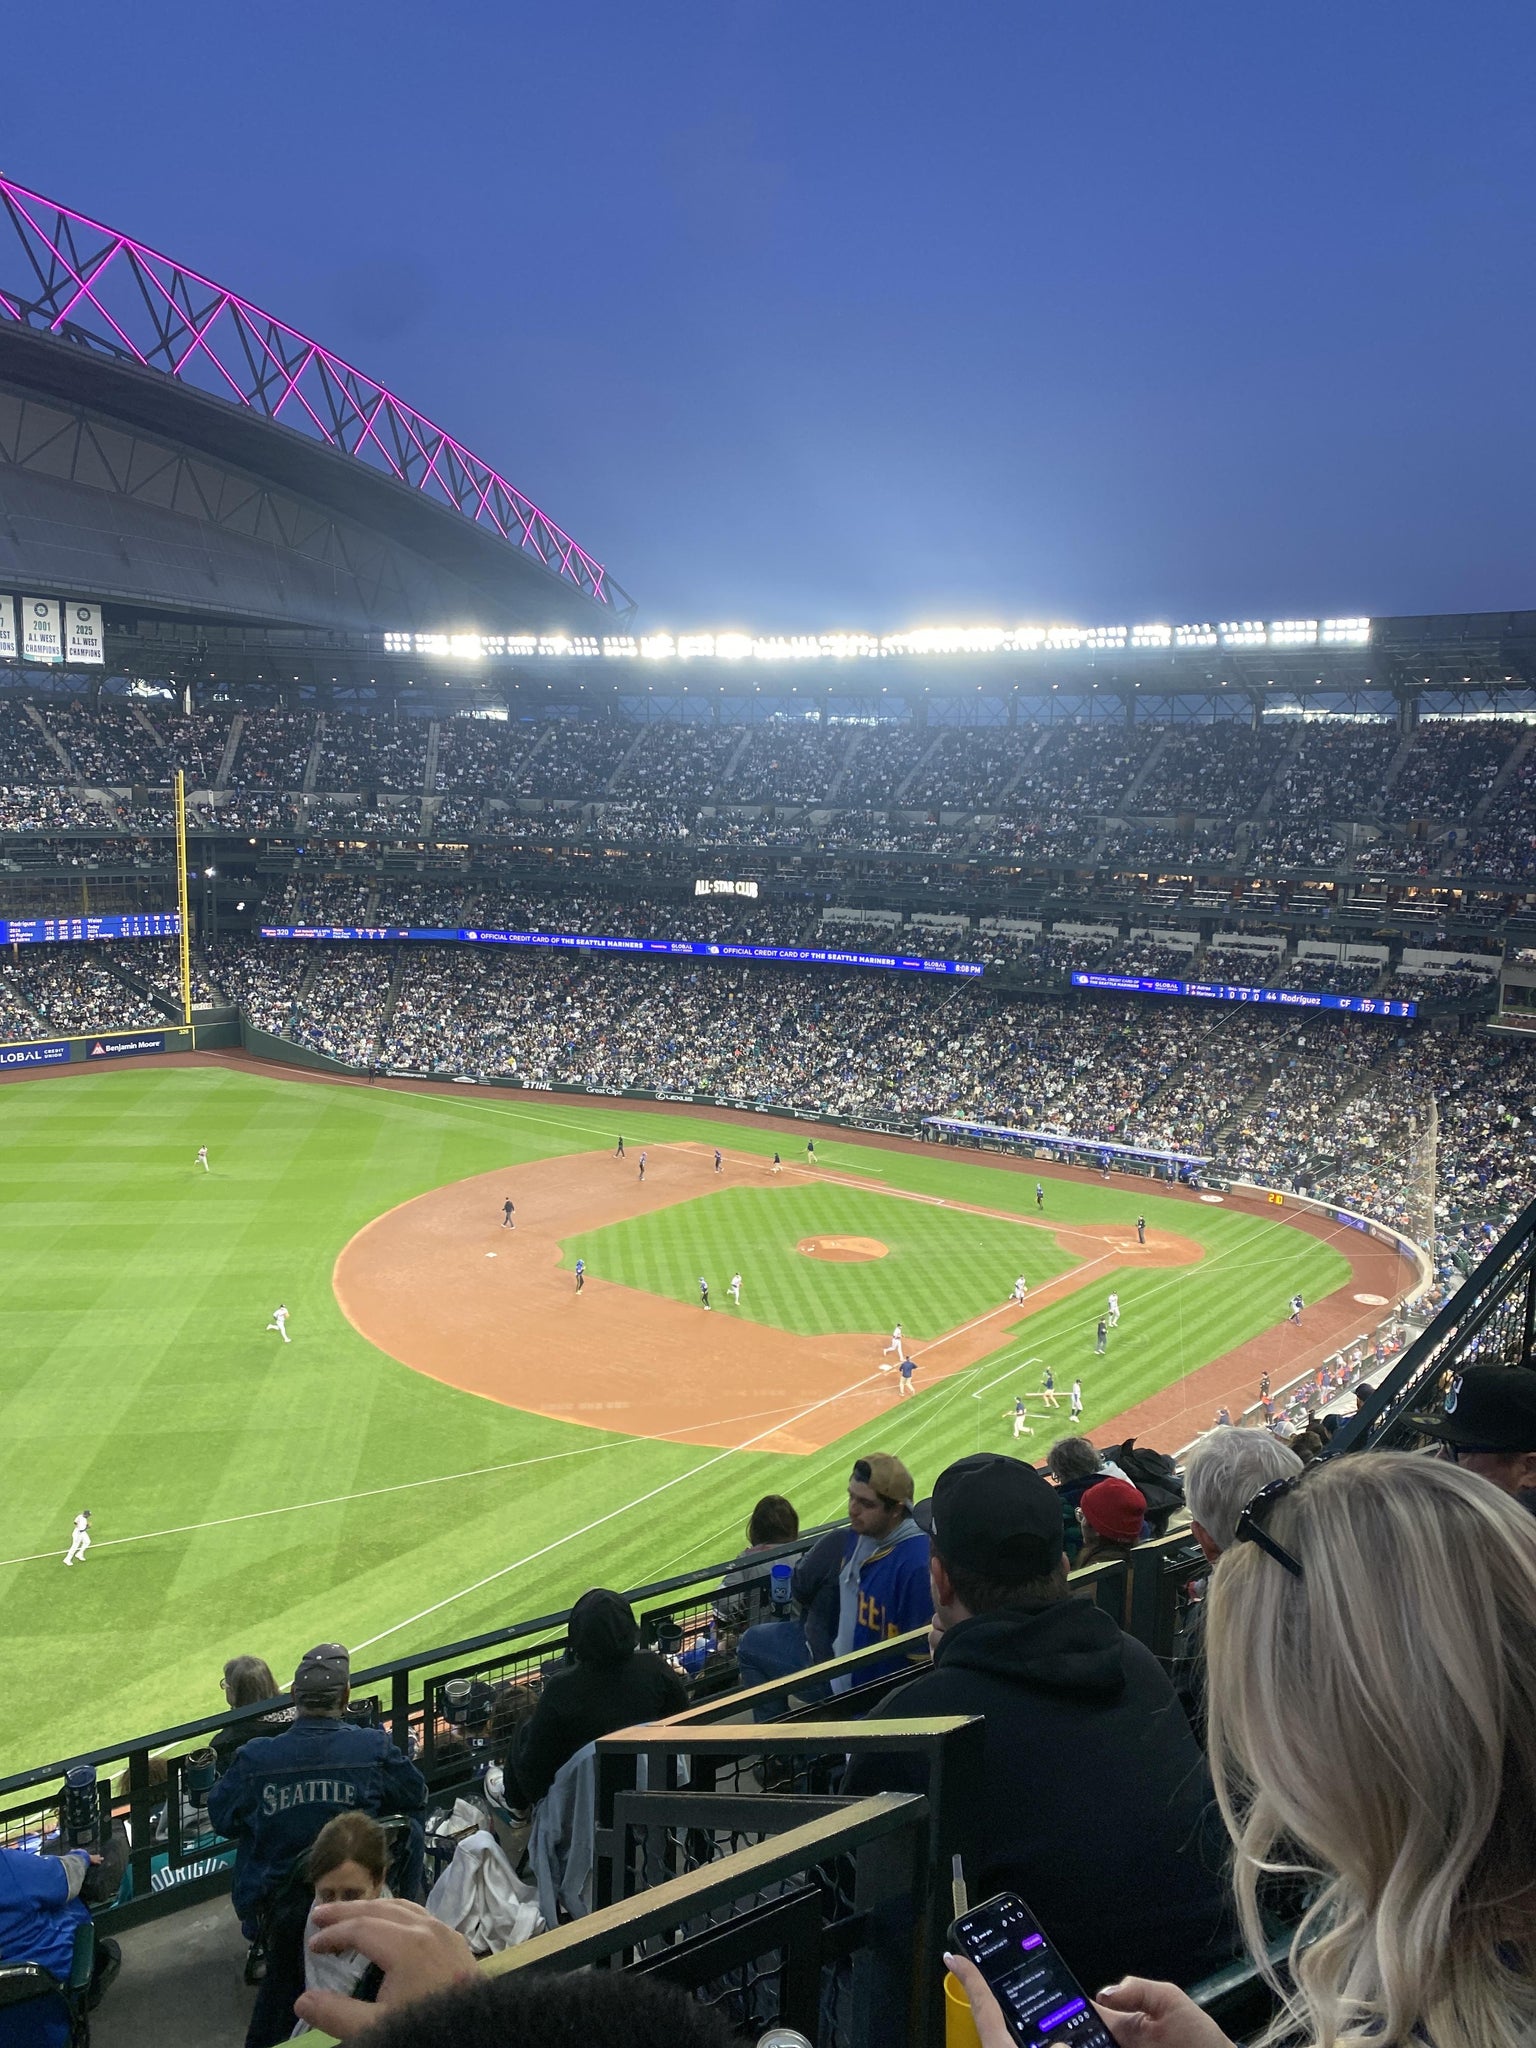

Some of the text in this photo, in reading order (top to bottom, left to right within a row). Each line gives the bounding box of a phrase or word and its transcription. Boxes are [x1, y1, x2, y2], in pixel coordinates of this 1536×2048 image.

[33, 620, 51, 631] 2001
[76, 625, 93, 635] 2025
[0, 630, 10, 639] EST
[40, 634, 56, 643] WEST
[83, 638, 97, 646] WEST
[25, 644, 59, 655] CHAMPIONS
[69, 647, 101, 658] CHAMPIONS
[735, 881, 758, 898] CLUB
[480, 932, 508, 941] OFFICIAL
[509, 934, 531, 942] CREDIT
[532, 935, 550, 943] CARD
[561, 937, 575, 945] THE
[576, 938, 605, 947] SEATTLE
[607, 940, 643, 949] MARINERS
[723, 947, 752, 955] OFFICIAL
[754, 949, 778, 957] CREDIT
[779, 950, 798, 958] CARD
[811, 952, 826, 960] THE
[827, 953, 858, 962] SEATTLE
[859, 956, 895, 965] MARINERS
[970, 966, 981, 974] PM
[1266, 992, 1277, 1001] 44
[1340, 999, 1351, 1007] CF
[1357, 1003, 1375, 1012] .157
[1402, 1008, 1408, 1016] 2
[105, 1040, 161, 1052] Benjamin Moore
[0, 1051, 42, 1063] LOBAL
[522, 1080, 553, 1091] STIHL
[586, 1086, 623, 1096] Great Clips
[665, 1094, 693, 1102] LEXUS
[262, 1780, 355, 1816] SEATTLE
